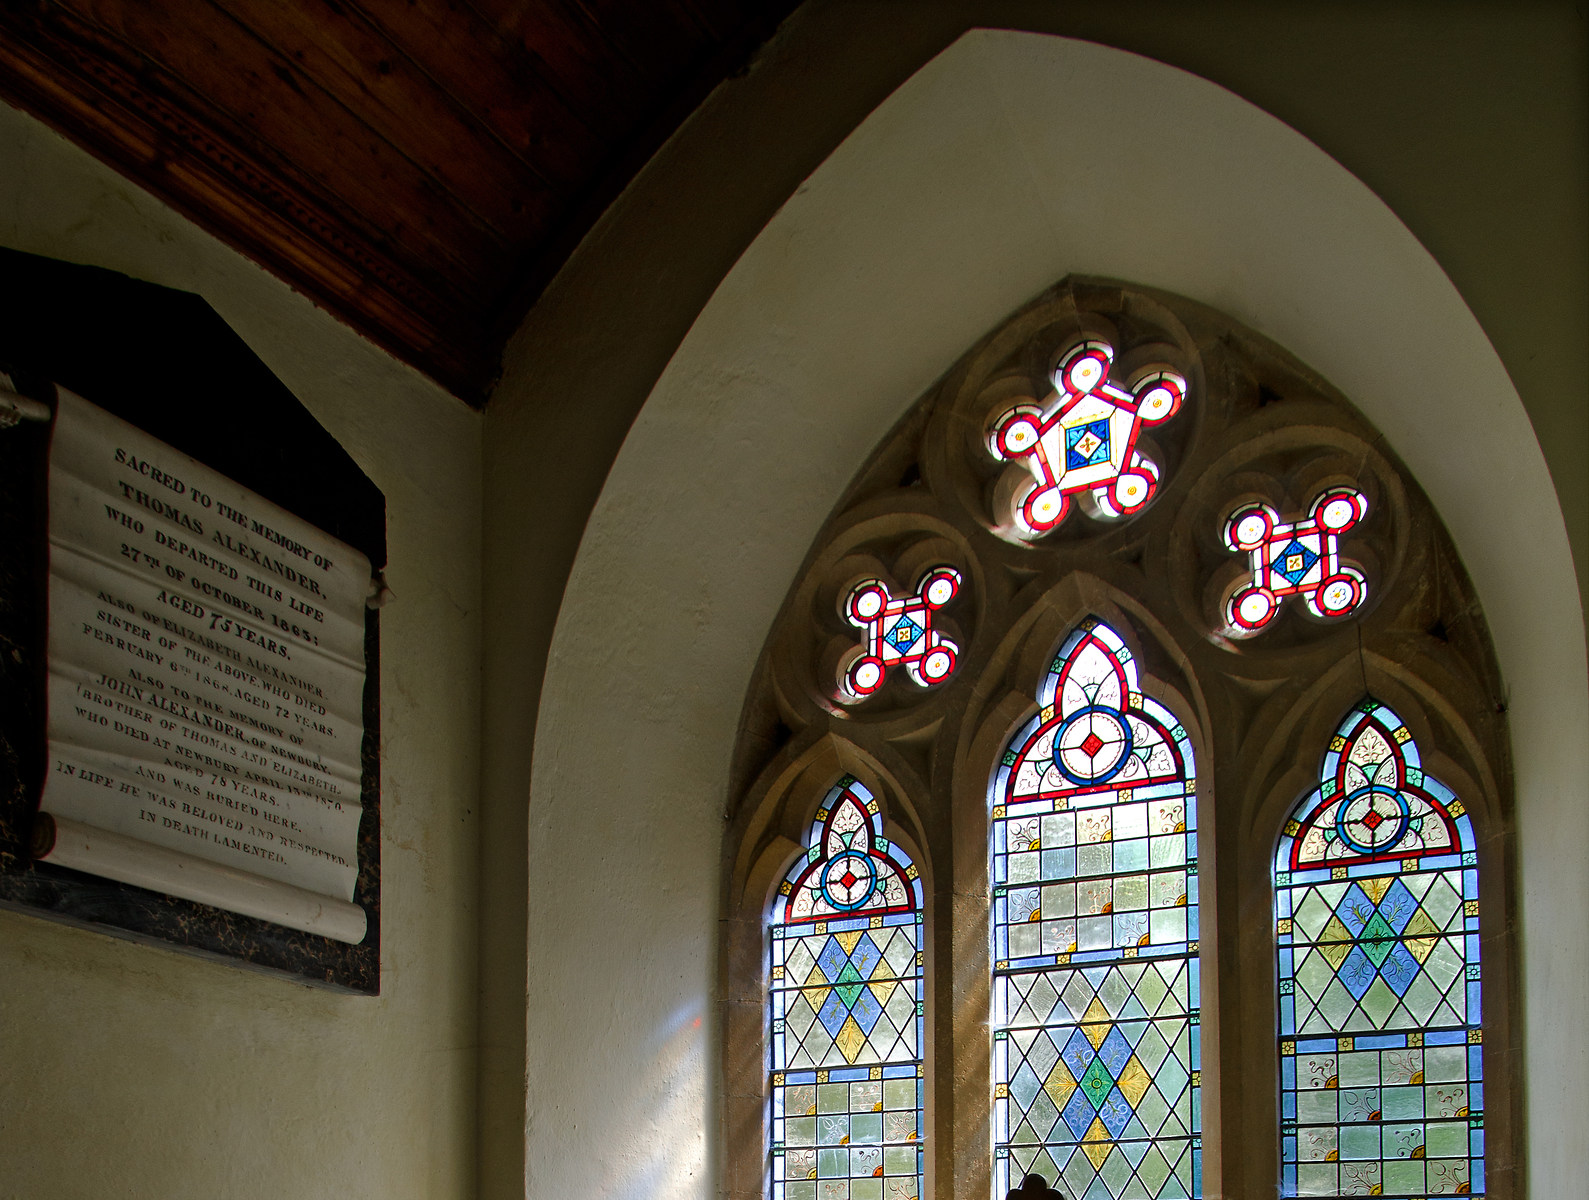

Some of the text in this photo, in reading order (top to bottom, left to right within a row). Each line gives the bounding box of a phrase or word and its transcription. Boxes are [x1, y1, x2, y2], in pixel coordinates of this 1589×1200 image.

[114, 448, 333, 572] SACRED TO THE MEMORY OF
[118, 480, 327, 599] THOMAS ALEXANDER,
[104, 504, 324, 623] WHO DEPARTED THIS LIFE
[165, 564, 186, 581] OF
[191, 578, 265, 620] OCTOBER
[96, 610, 151, 641] SISTER
[158, 635, 178, 650] OF
[184, 646, 211, 666] THE
[261, 680, 290, 700] WHO
[294, 696, 326, 716] DIED
[97, 591, 136, 614] ALSO
[142, 611, 161, 624] OF
[162, 618, 241, 662] ELIZABETH
[156, 590, 292, 661] AGED 75 YEARS.
[82, 622, 164, 666] FEBRUARY
[234, 688, 270, 711] AGED
[275, 706, 289, 719] 72
[294, 714, 337, 739] YEARS.
[95, 674, 144, 701] JOHN
[252, 737, 266, 750] OF
[128, 668, 304, 746] ALSO TO THE MEMORY OF
[74, 706, 108, 726] WHO
[113, 721, 150, 742] DIED
[153, 736, 171, 750] AT
[175, 744, 239, 776] NEWBURY
[244, 770, 284, 790] APRIL
[160, 718, 177, 732] OF
[181, 726, 238, 756] THOMAS
[240, 750, 268, 767] AND
[56, 760, 350, 868] IN LIFE HE WAS BELOVED AND RESPECTED.
[136, 765, 302, 834] AND WAS BURIED HERE.
[164, 757, 280, 807] AGED 78 YEARS.
[138, 810, 288, 866] IN DEATH LAMENTED.
